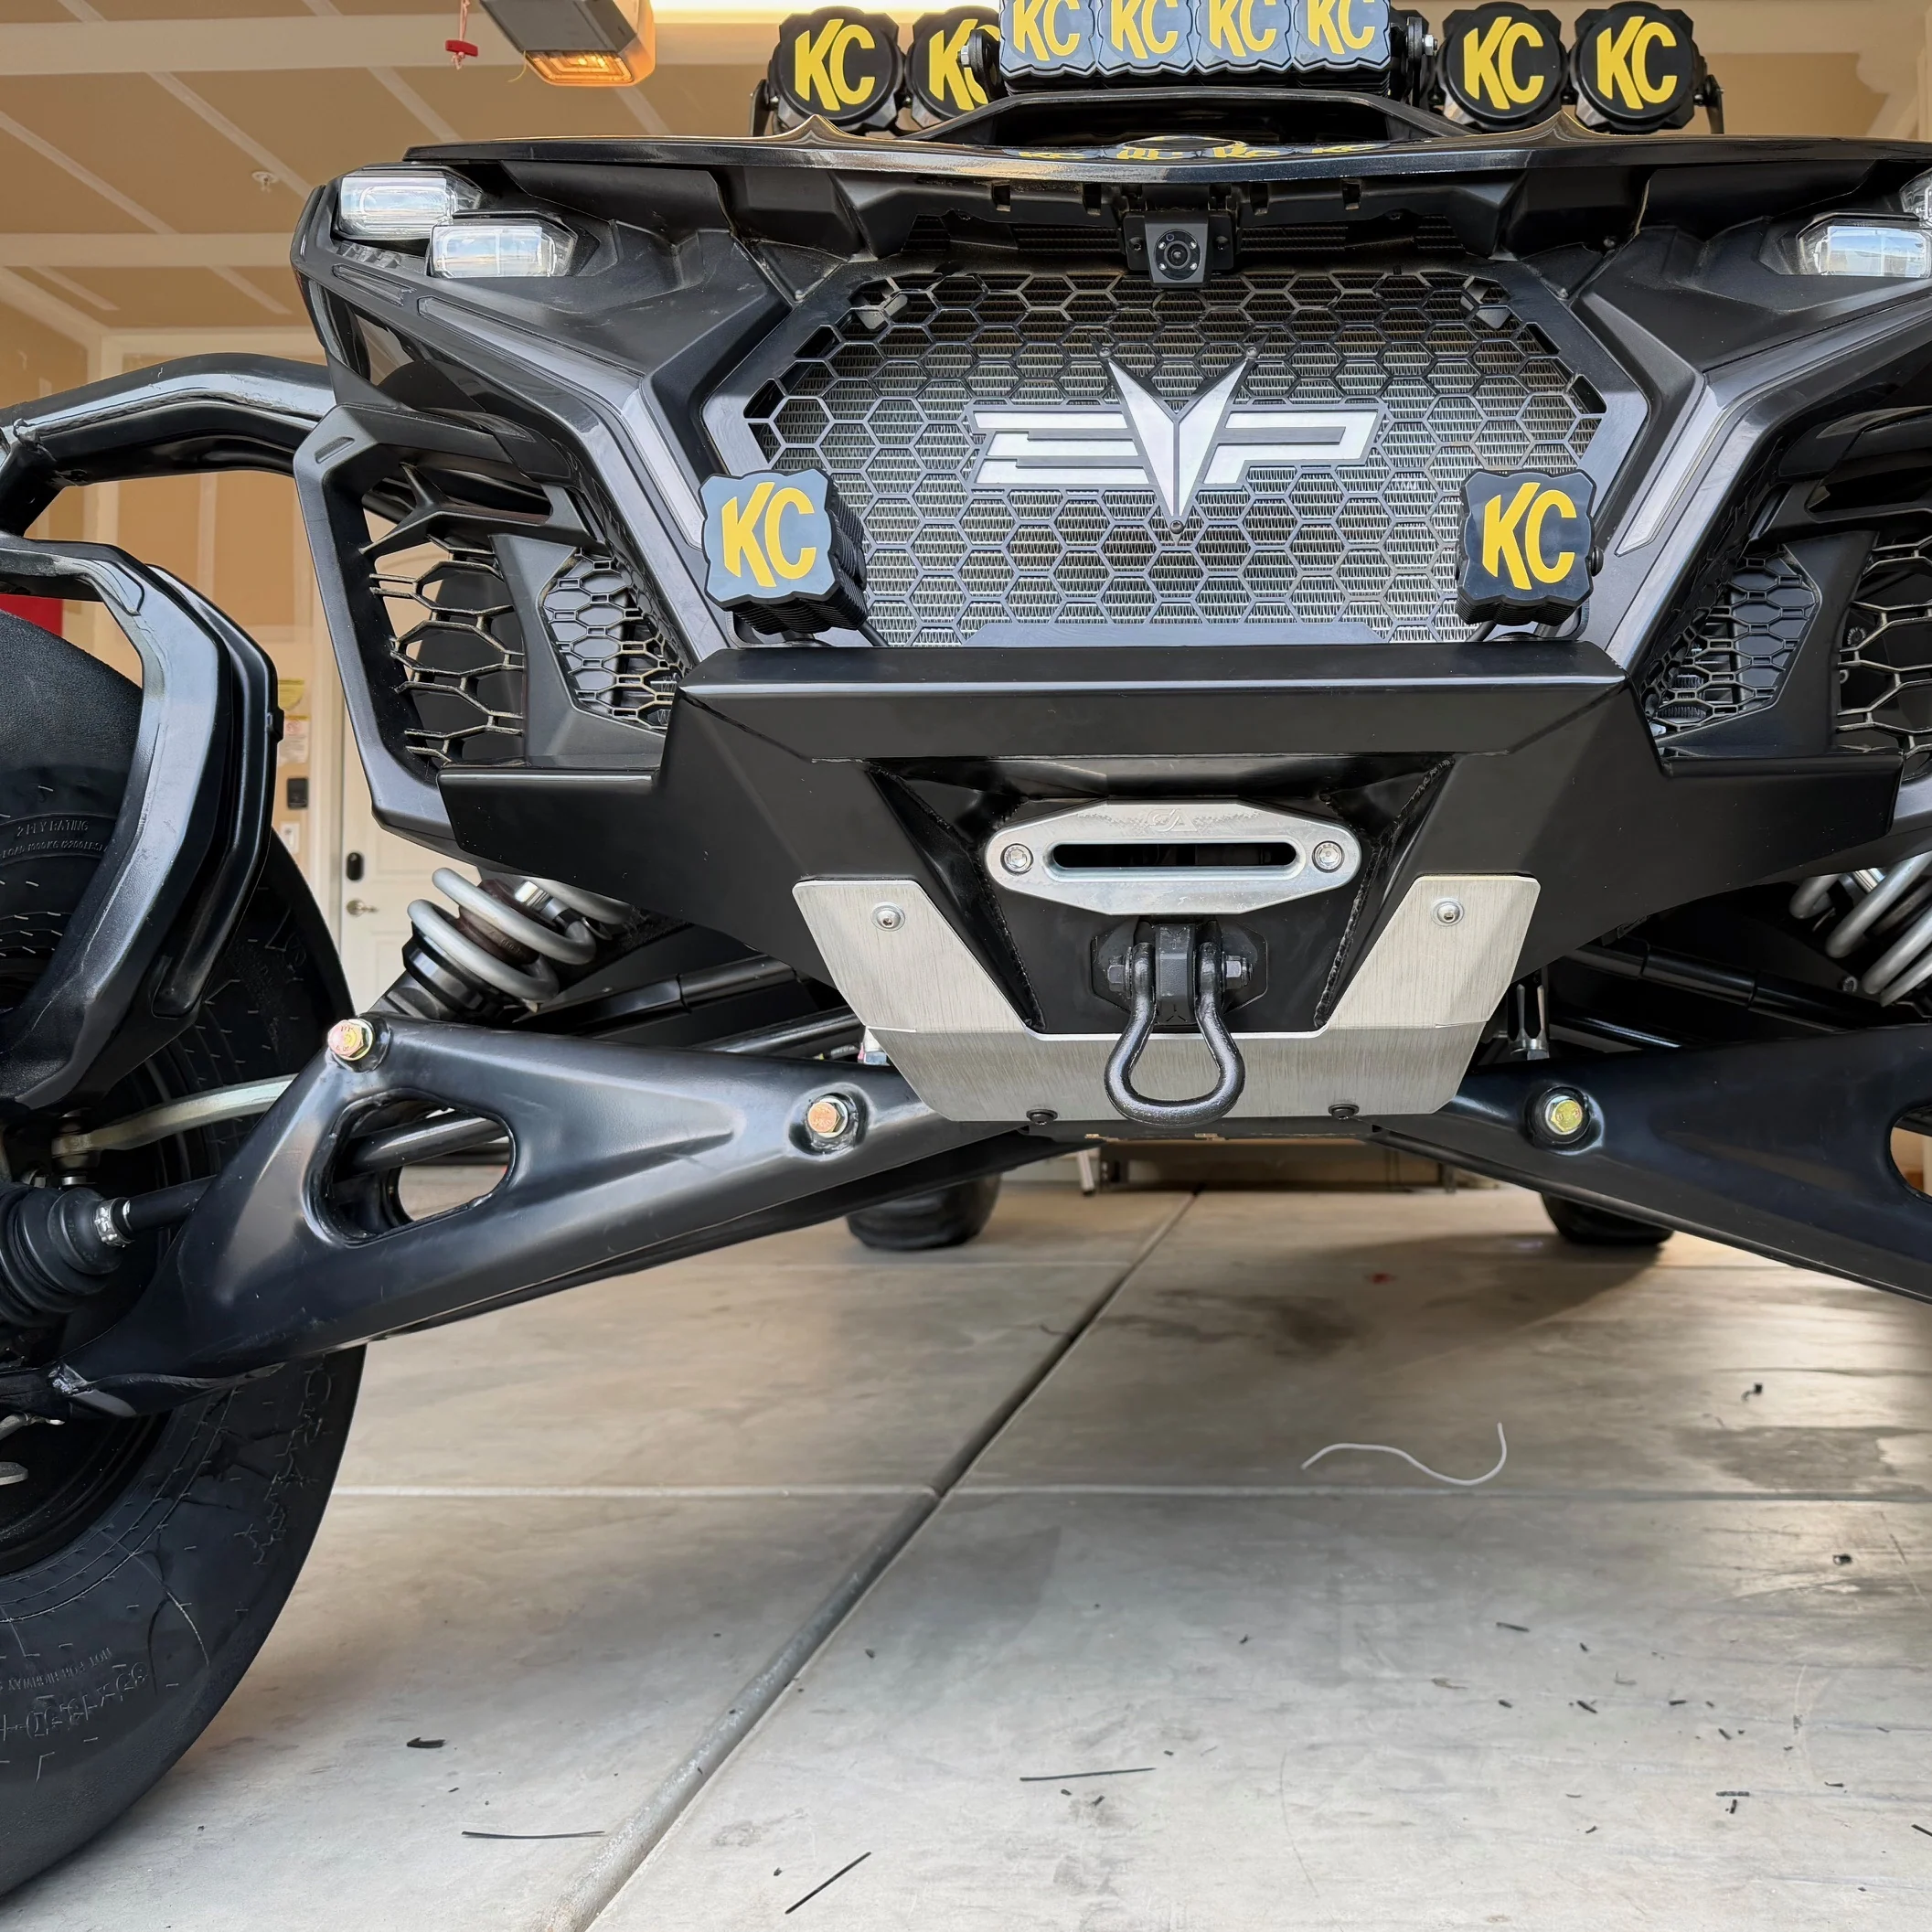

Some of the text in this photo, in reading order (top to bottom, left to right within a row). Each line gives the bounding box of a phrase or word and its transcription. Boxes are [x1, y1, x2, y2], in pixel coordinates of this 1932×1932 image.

[1013, 0, 1081, 61] KC
[1111, 0, 1178, 59] KC
[1209, 0, 1276, 57] KC
[1308, 0, 1375, 55] KC
[795, 18, 875, 112] KC
[1463, 16, 1545, 111] KC
[1596, 16, 1678, 110] KC
[721, 482, 817, 587] KC
[1482, 481, 1577, 591] KC
[49, 819, 89, 831] RATING
[8, 1672, 59, 1692] HIGHWAY
[61, 1661, 86, 1677] FOR
[89, 1647, 113, 1667] NOT
